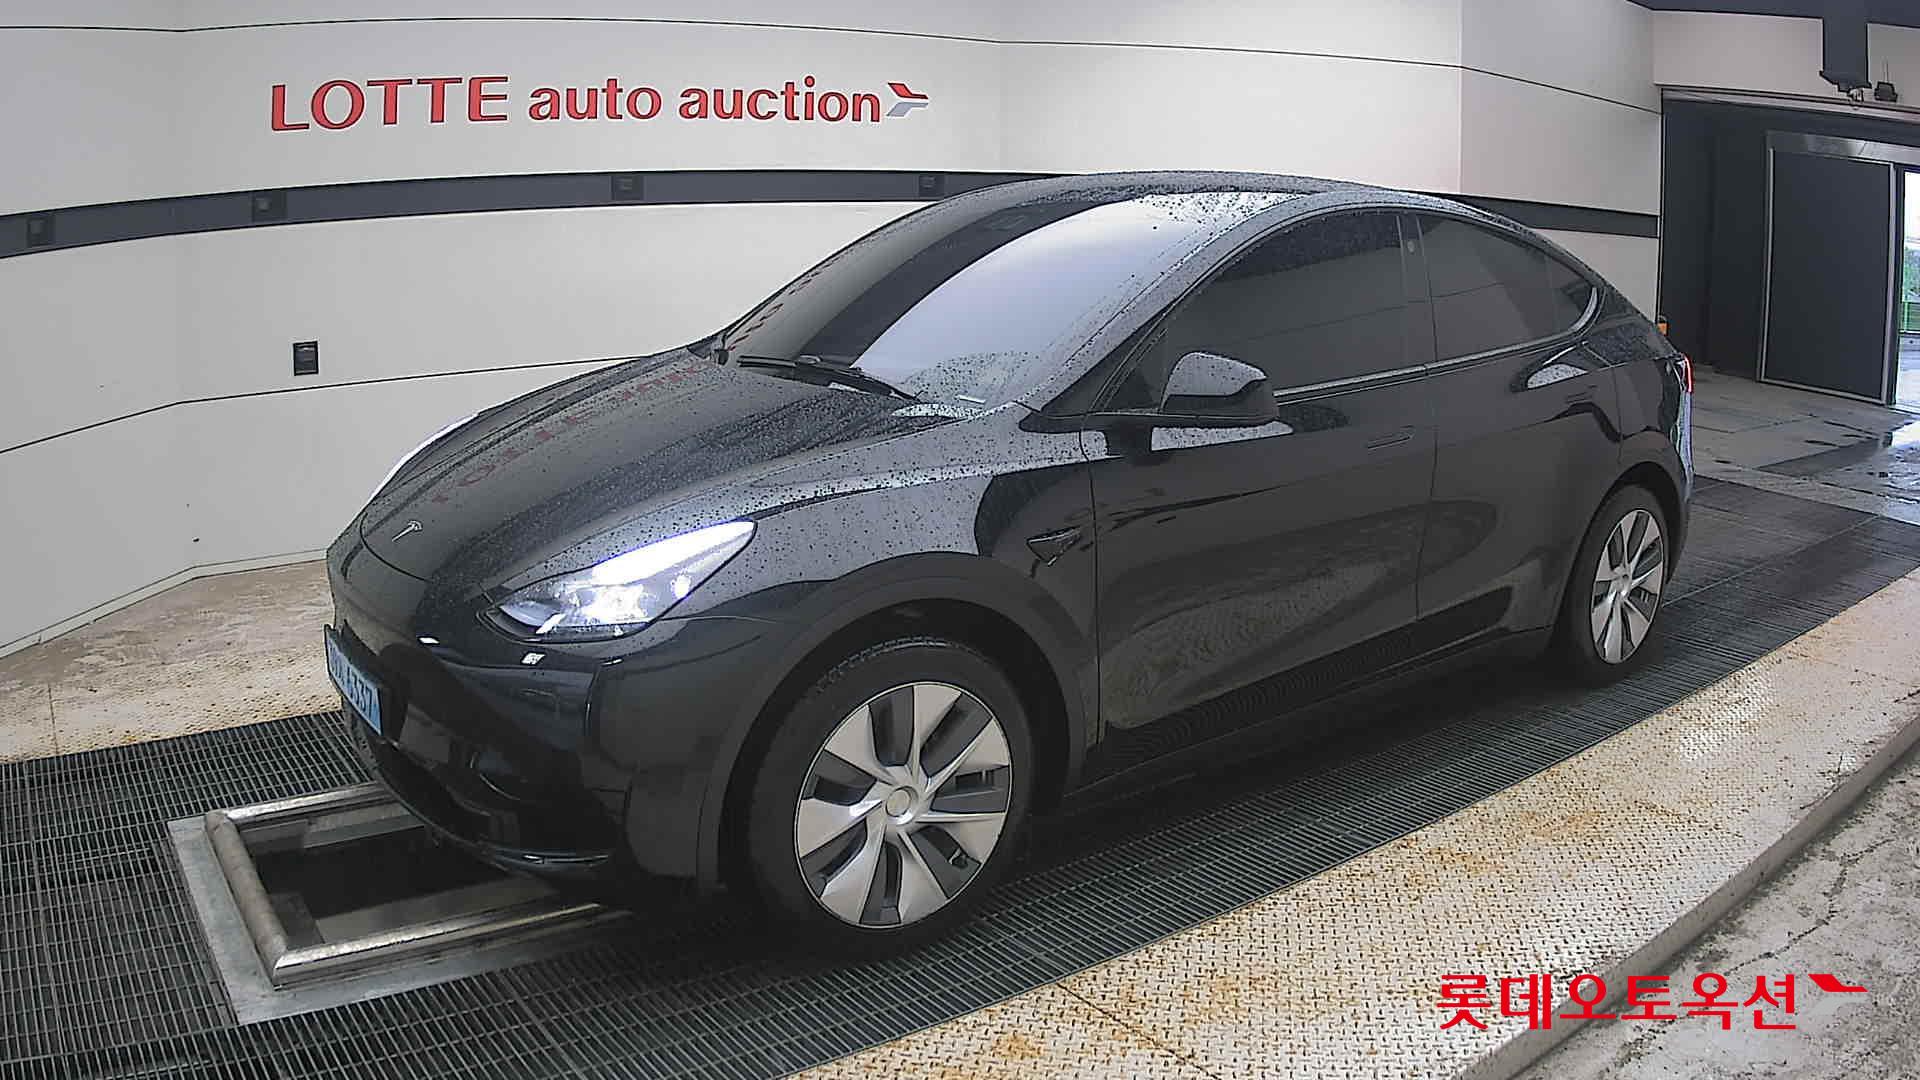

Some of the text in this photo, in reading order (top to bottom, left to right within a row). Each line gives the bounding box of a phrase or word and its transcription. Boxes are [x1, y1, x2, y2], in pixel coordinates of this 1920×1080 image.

[270, 76, 881, 131] LOTTE auto auction
